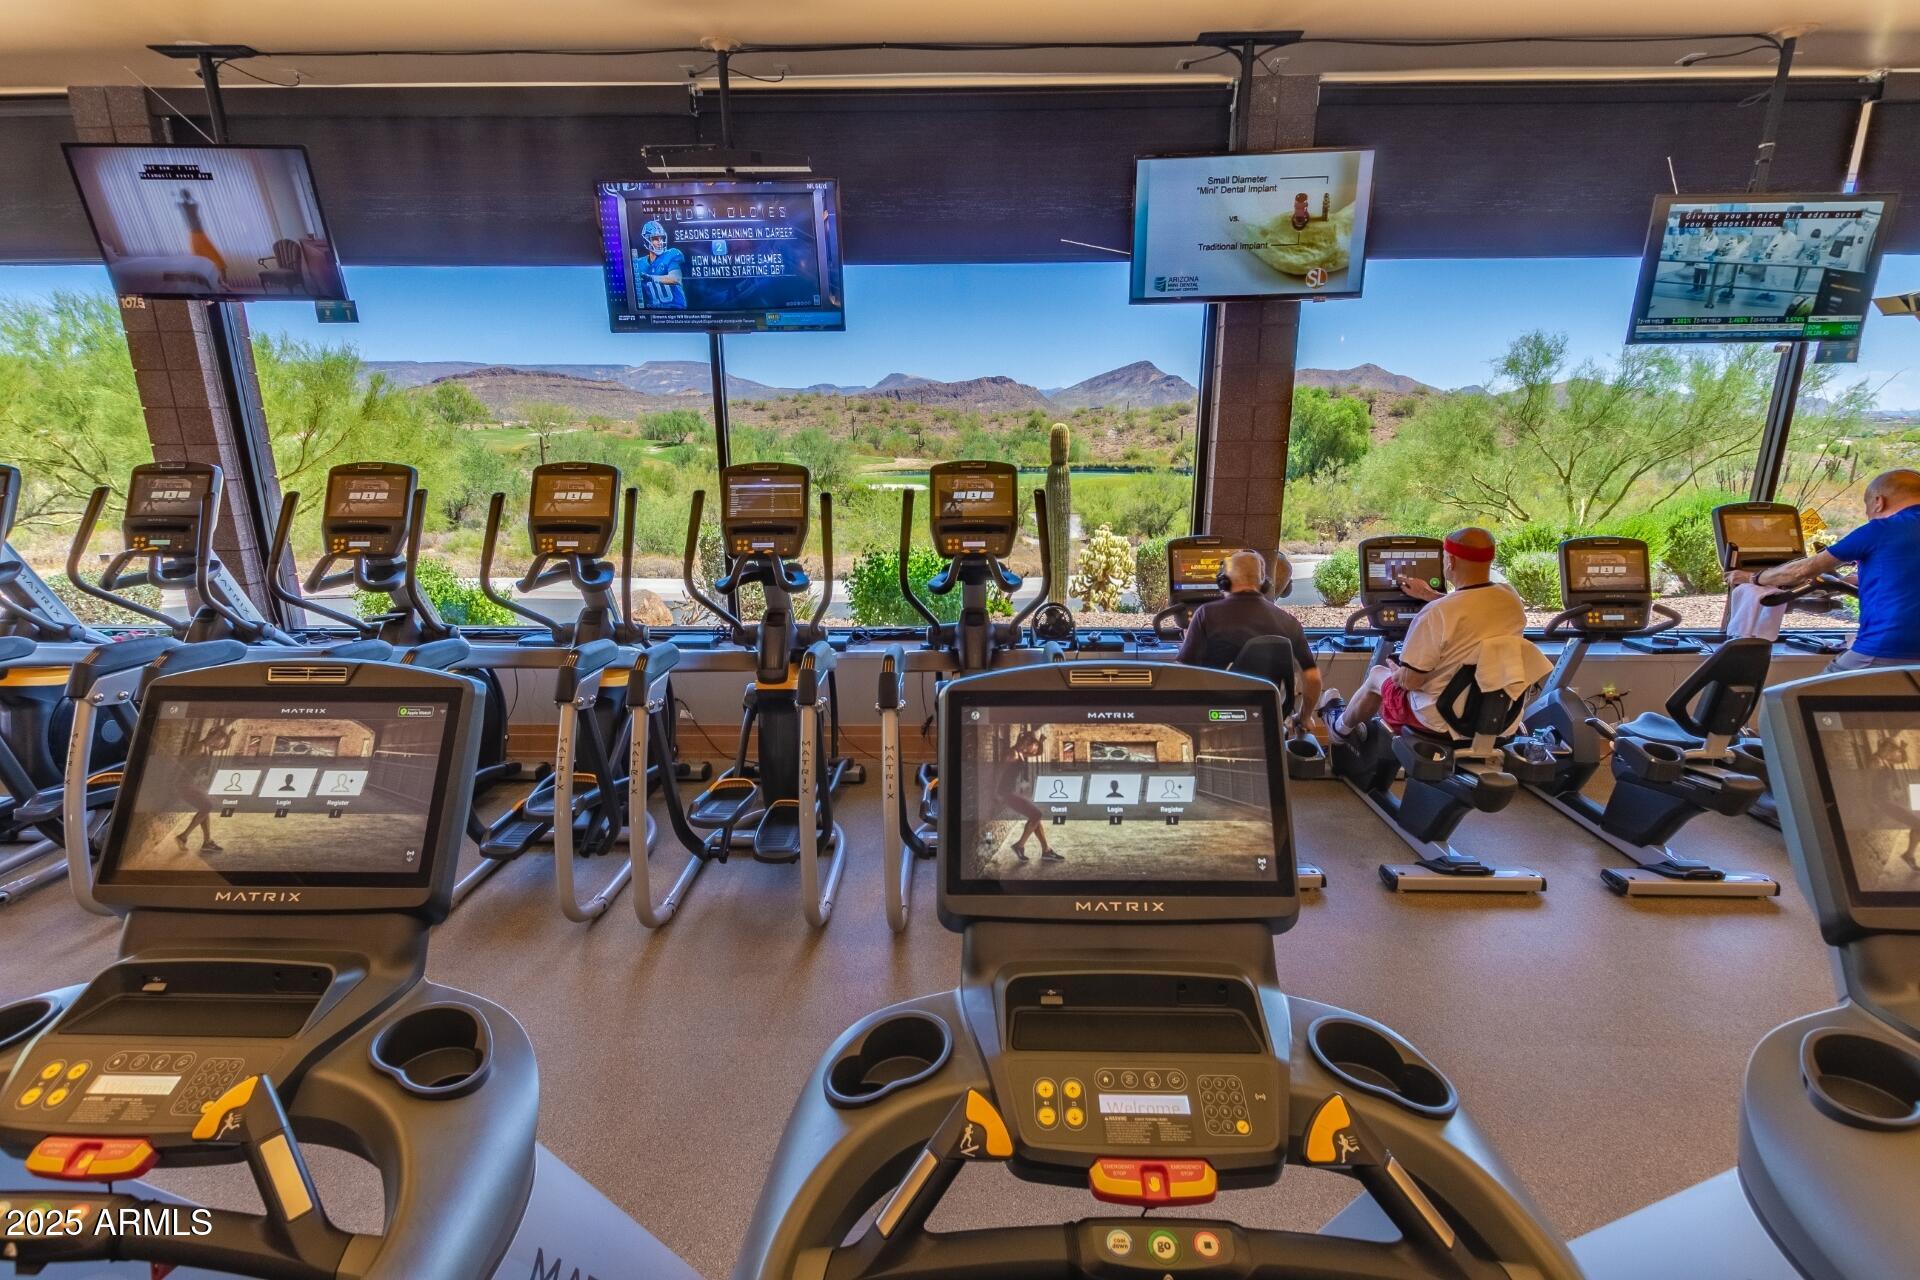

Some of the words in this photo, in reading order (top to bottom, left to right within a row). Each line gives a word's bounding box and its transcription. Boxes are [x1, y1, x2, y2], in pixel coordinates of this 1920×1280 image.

[1207, 176, 1229, 185] Small
[1231, 175, 1268, 184] Diameter
[1220, 185, 1246, 194] Dental
[1248, 184, 1278, 194] Implant
[1685, 213, 1719, 221] Giving
[1724, 213, 1741, 221] you
[1807, 211, 1830, 219] edge
[1711, 219, 1778, 228] competition.
[674, 229, 710, 241] SEASONS
[711, 228, 753, 239] REMAINING
[755, 228, 763, 238] IN
[715, 243, 724, 252] 2
[1197, 242, 1238, 251] Traditional
[691, 255, 710, 266] HOW
[711, 255, 733, 266] MANY
[734, 254, 756, 265] MORE
[691, 267, 702, 277] AS
[703, 266, 732, 277] GIANTS
[732, 265, 769, 276] STARTING
[556, 737, 569, 791] MATRIX
[630, 740, 641, 794] MATRIX
[801, 740, 811, 794] MATRIX
[884, 745, 895, 799] MATRIX
[1107, 806, 1124, 814] Login
[1160, 806, 1185, 814] Register
[214, 892, 302, 903] MATRIX
[1075, 901, 1165, 912] MATRIX
[1106, 1100, 1181, 1114] Welcome
[1157, 1242, 1171, 1253] go
